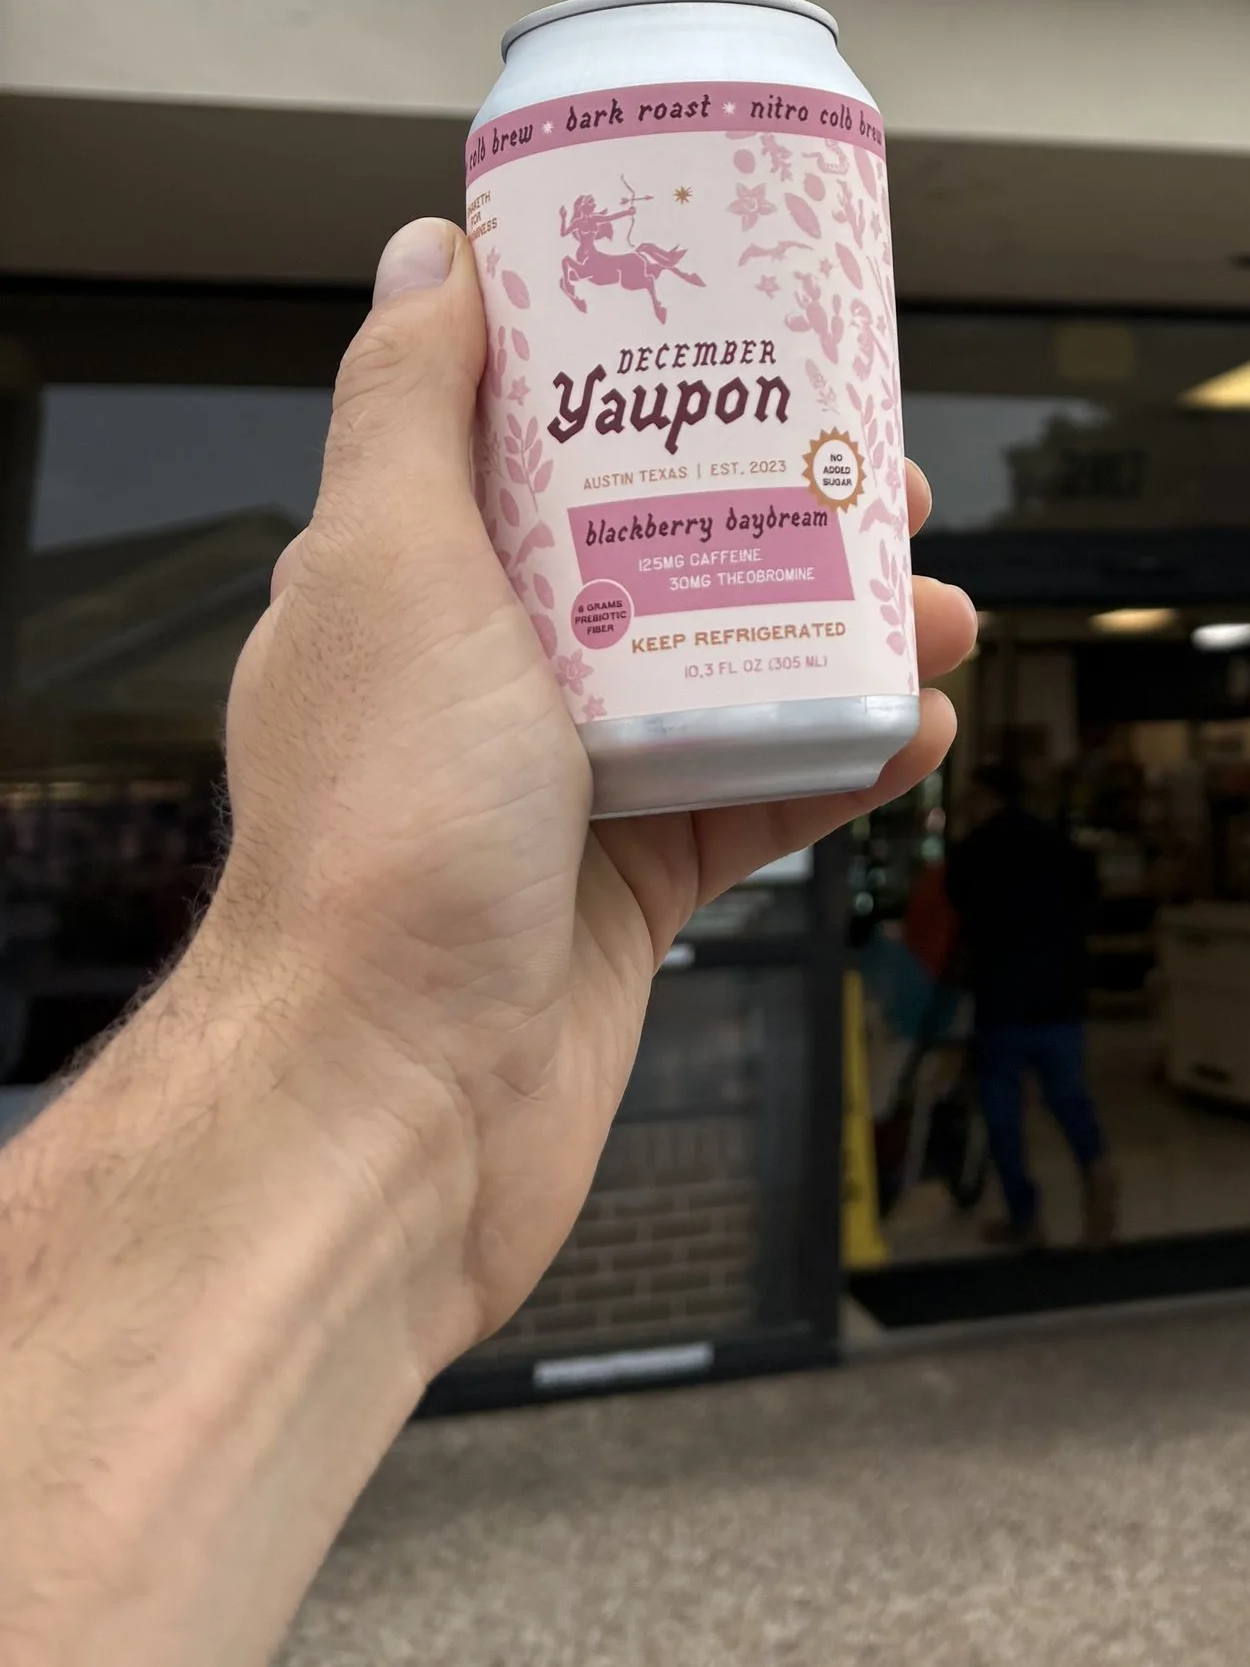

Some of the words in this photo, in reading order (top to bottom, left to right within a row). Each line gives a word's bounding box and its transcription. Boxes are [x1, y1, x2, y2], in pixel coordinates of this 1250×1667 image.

[565, 98, 624, 132] dark
[638, 94, 711, 121] roast
[750, 94, 809, 122] nitro
[820, 103, 852, 131] cold
[469, 136, 486, 171] cold
[492, 124, 533, 155] brew
[616, 338, 776, 375] DECEMBER
[546, 363, 791, 455] Yaupon
[822, 465, 851, 475] ADDED
[830, 453, 843, 462] NO
[583, 471, 634, 490] AUSTIN
[639, 465, 688, 482] TEXAS
[710, 461, 745, 477] EST.
[749, 459, 787, 474] 2023
[822, 477, 853, 487] SUGAR
[586, 513, 713, 547] blackberry
[726, 504, 828, 539] daydream
[638, 553, 685, 572] 125MG
[690, 547, 763, 567] CAFFEINE
[669, 572, 712, 591] 30MG
[717, 566, 816, 585] THEOBROMINE
[574, 610, 628, 626] PREBIOTIC
[587, 599, 623, 613] GRAMS
[586, 623, 615, 636] FIBER
[631, 633, 687, 654] KEEP
[694, 621, 847, 647] REFRIGERATED
[684, 665, 714, 680] 10.3
[719, 661, 737, 675] FL
[743, 658, 763, 673] OZ
[768, 655, 802, 672] (305
